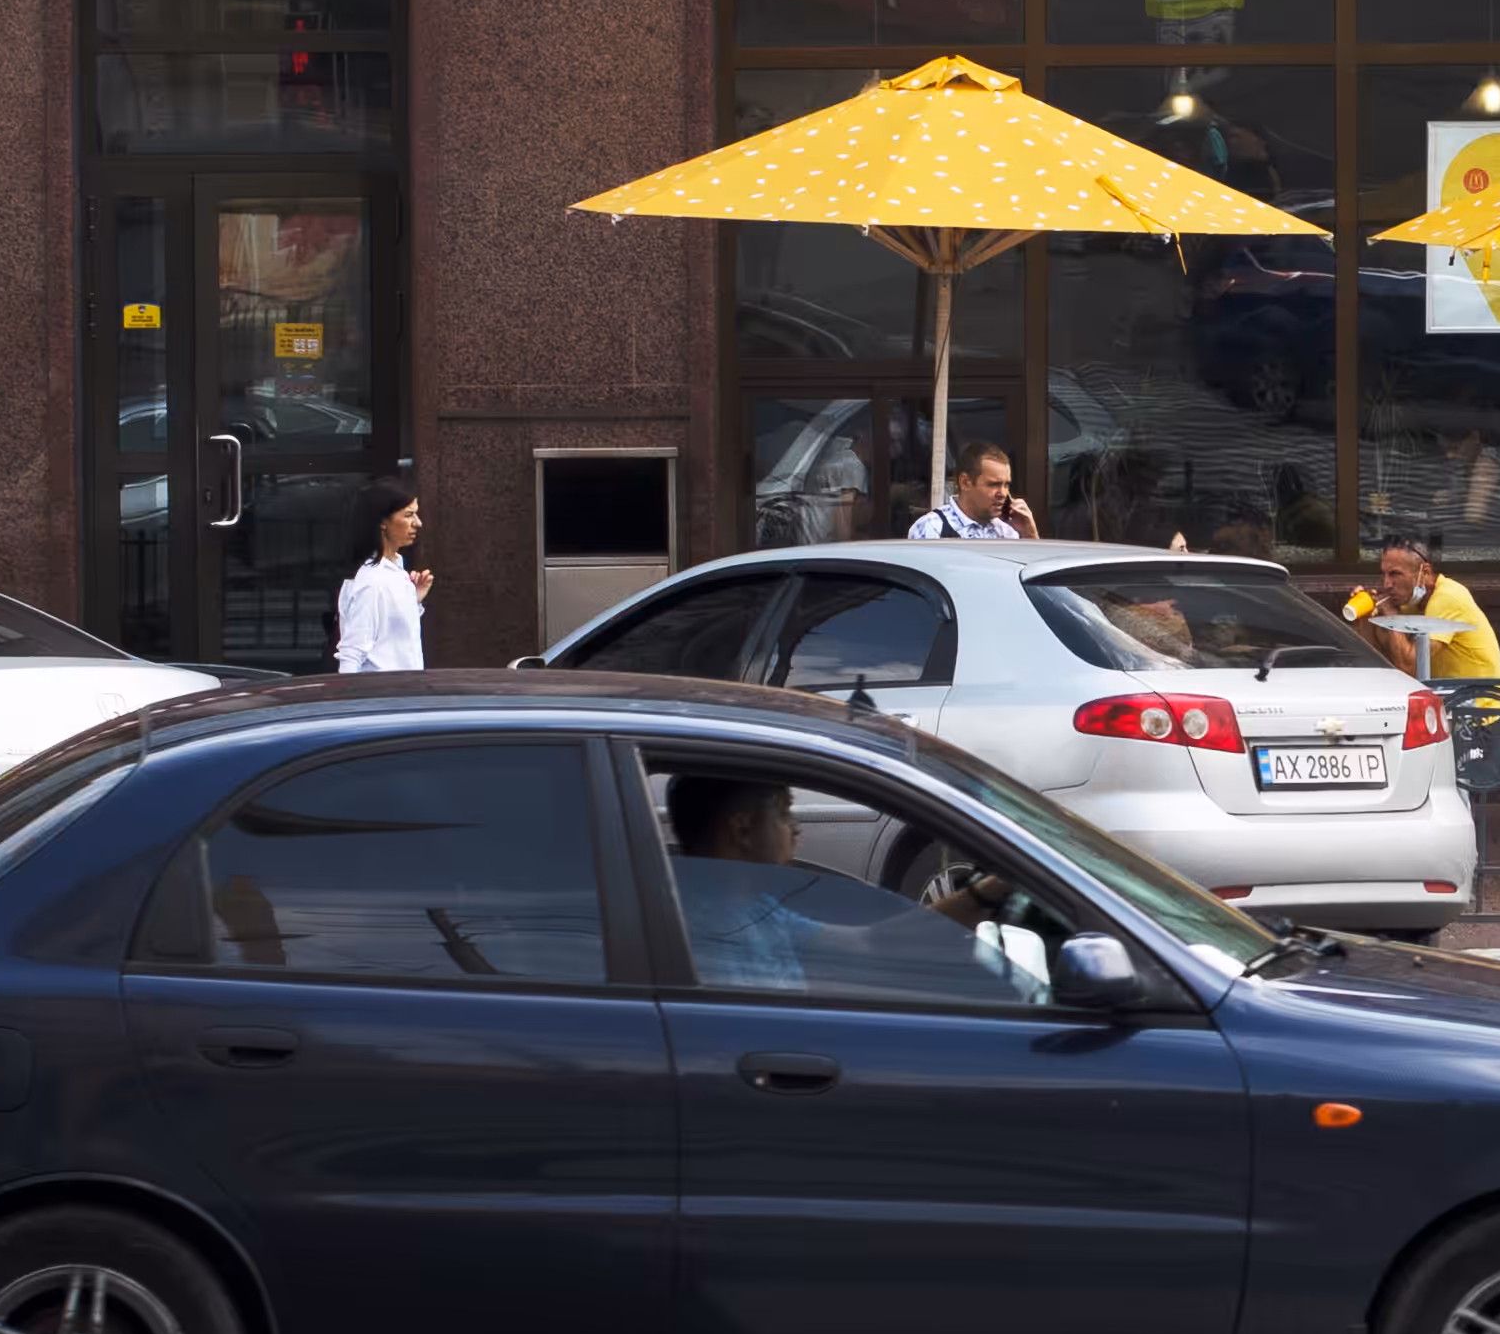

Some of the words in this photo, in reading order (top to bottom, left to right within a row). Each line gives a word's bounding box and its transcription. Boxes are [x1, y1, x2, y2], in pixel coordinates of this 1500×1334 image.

[1275, 754, 1302, 780] AX
[1306, 754, 1351, 779] 2886
[1358, 754, 1380, 779] IP
